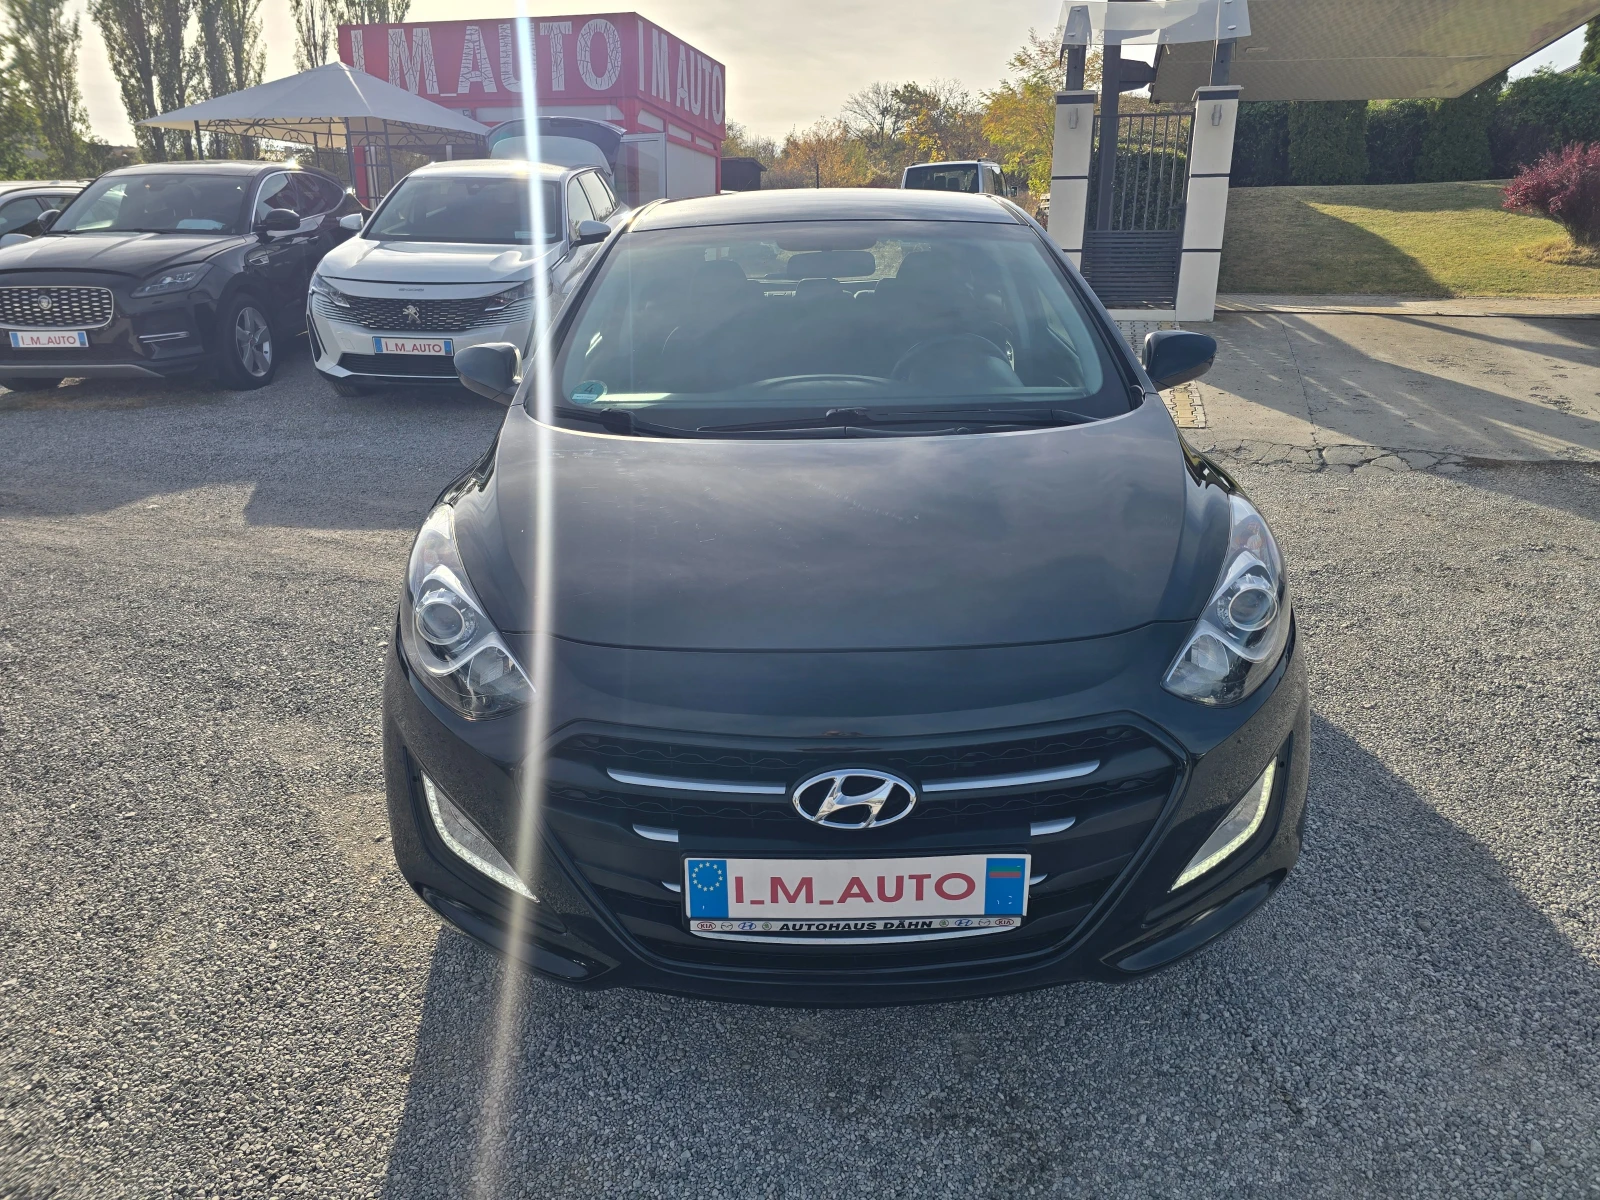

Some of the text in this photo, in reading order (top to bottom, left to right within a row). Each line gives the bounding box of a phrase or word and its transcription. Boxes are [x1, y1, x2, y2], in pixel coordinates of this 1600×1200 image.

[676, 44, 723, 125] AUTO
[584, 383, 595, 394] 4
[735, 873, 976, 905] I_M_AUTO
[698, 918, 1013, 931] KIA AUTOHAUS DÄHN KIA
